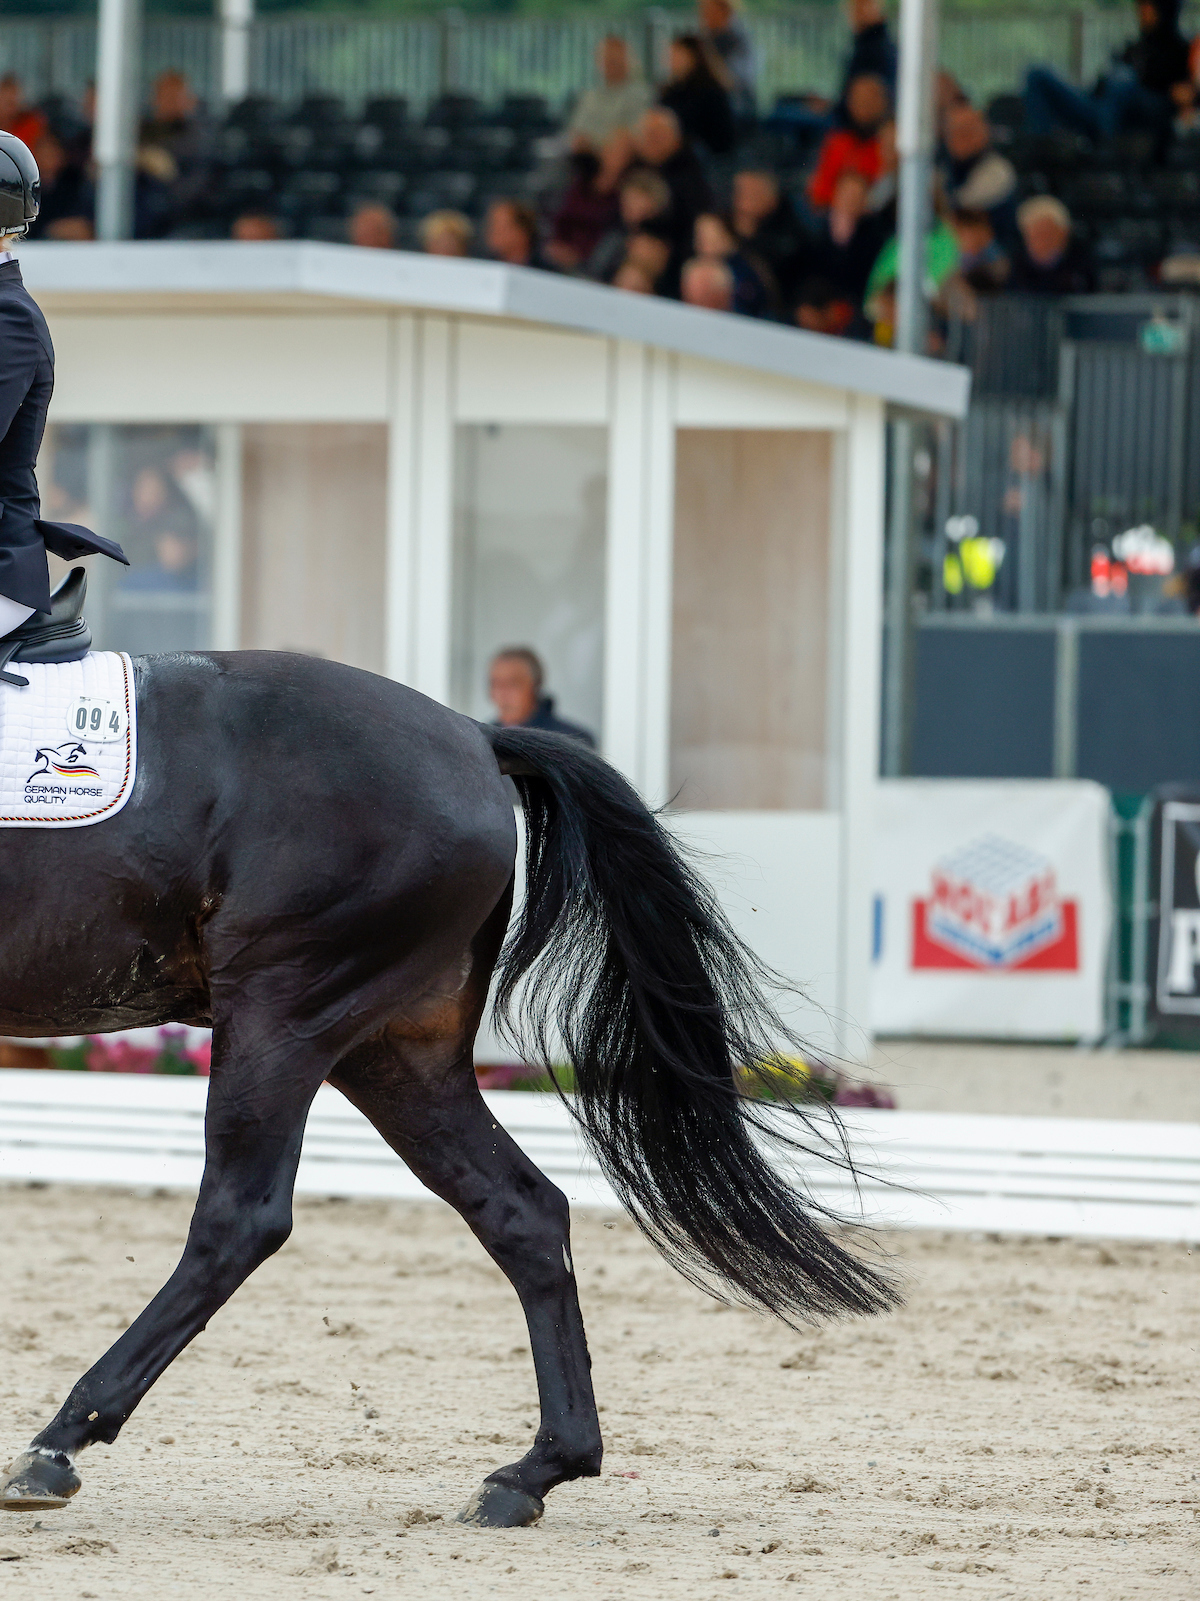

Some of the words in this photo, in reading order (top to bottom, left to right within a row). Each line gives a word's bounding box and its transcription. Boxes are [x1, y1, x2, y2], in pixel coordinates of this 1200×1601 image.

[24, 785, 67, 795] GERMAN
[69, 787, 103, 797] HORSE
[23, 795, 67, 804] QUALITY
